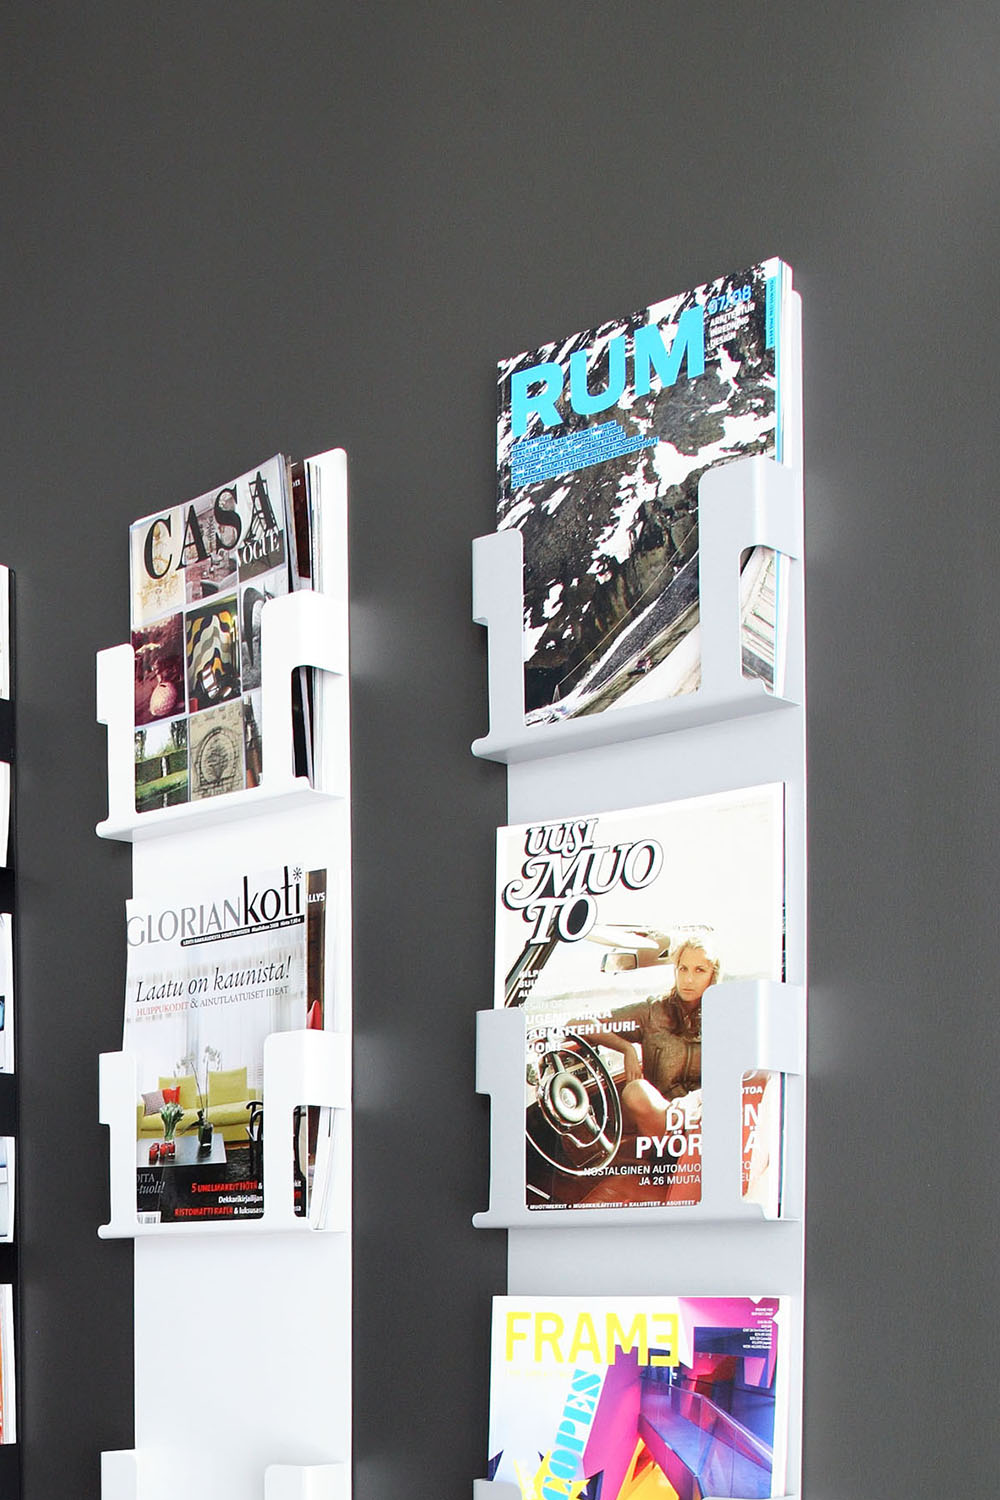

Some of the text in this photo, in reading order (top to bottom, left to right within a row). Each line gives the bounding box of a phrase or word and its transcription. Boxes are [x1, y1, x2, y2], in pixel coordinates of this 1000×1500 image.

[709, 302, 755, 327] ARKITEKTUR
[511, 305, 705, 437] RUM
[144, 471, 281, 580] CASA
[525, 818, 599, 857] UUSI
[502, 839, 664, 910] MUO
[523, 893, 598, 944] TO
[136, 956, 292, 1003] Laatu on kaunista!
[136, 985, 288, 1016] HUIPPUKODIT & AINUTLAATUISET IDEAT
[667, 1108, 702, 1131] DE
[191, 1182, 198, 1193] 5
[584, 1165, 650, 1176] NOSTALGINEN
[638, 1177, 651, 1186] JA
[653, 1177, 664, 1186] 26
